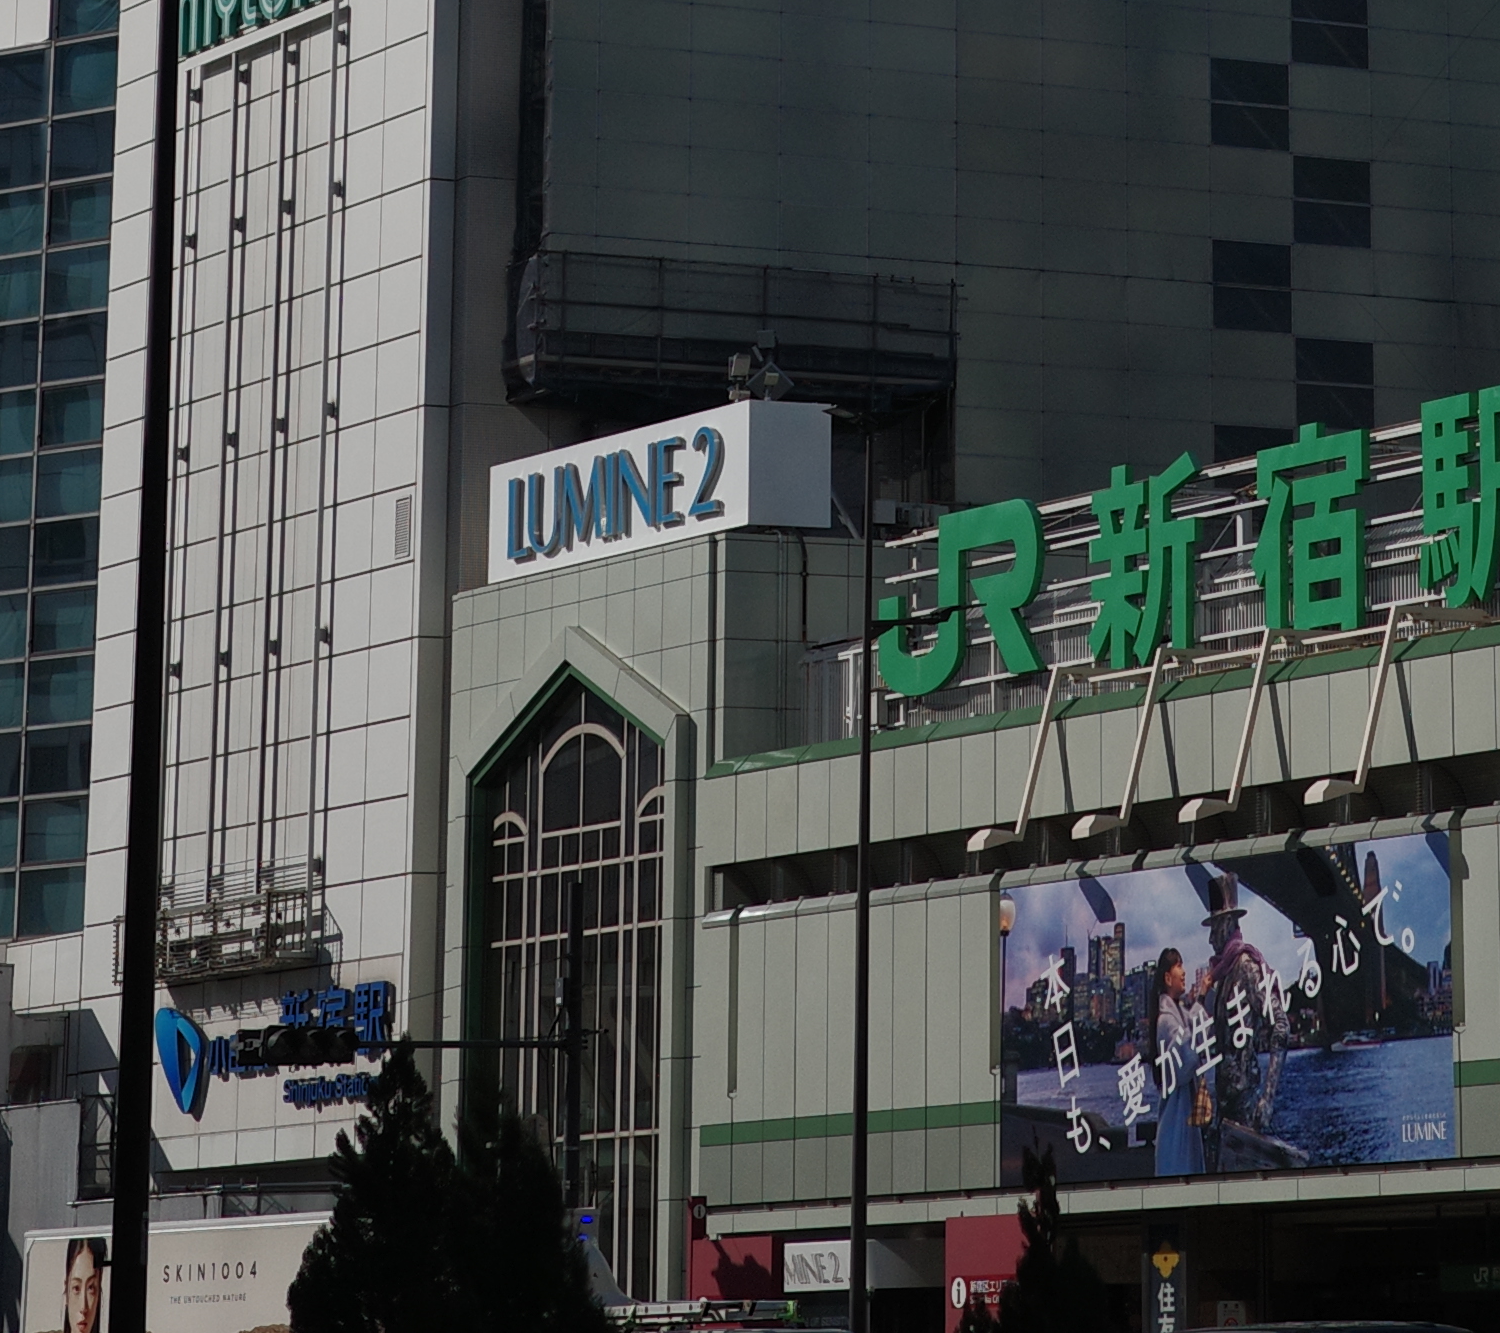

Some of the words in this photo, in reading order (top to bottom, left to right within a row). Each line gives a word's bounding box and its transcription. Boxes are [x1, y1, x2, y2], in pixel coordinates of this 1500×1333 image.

[506, 436, 687, 565] LUMINE
[688, 426, 726, 522] 2
[1401, 1120, 1448, 1143] LUMINE
[162, 1260, 258, 1283] SKIN1004
